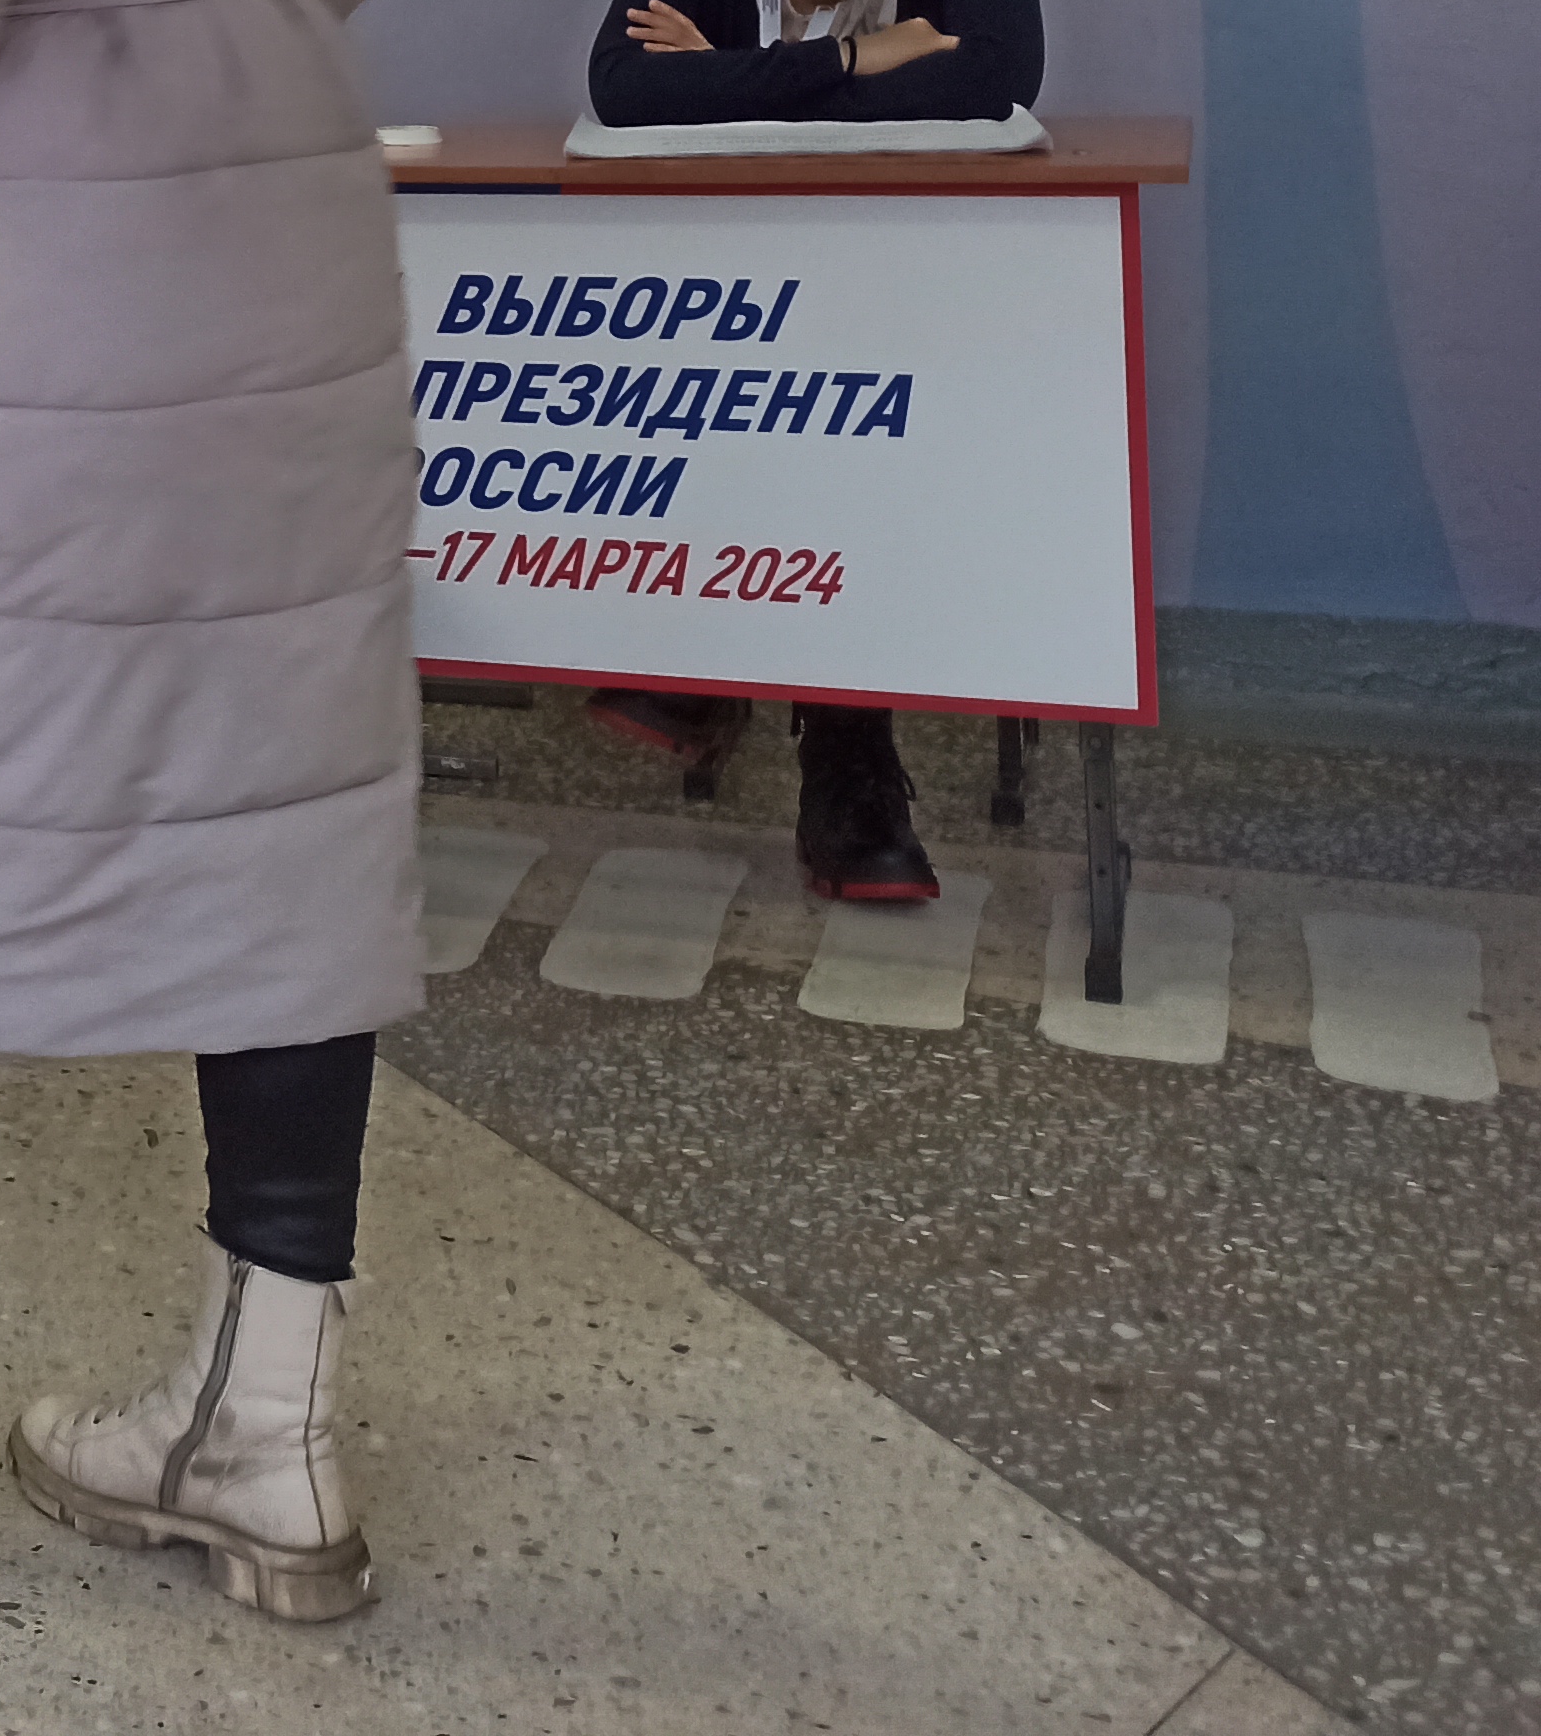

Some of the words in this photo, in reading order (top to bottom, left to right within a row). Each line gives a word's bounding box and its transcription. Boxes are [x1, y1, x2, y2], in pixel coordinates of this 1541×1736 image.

[436, 274, 801, 343] ВЫБОРЫ
[408, 359, 914, 441] ПРЕЗИДЕНТА
[415, 446, 689, 518] ОССИИ
[403, 530, 497, 583] –17
[496, 533, 690, 597] МАРТА
[698, 545, 845, 605] 2024
